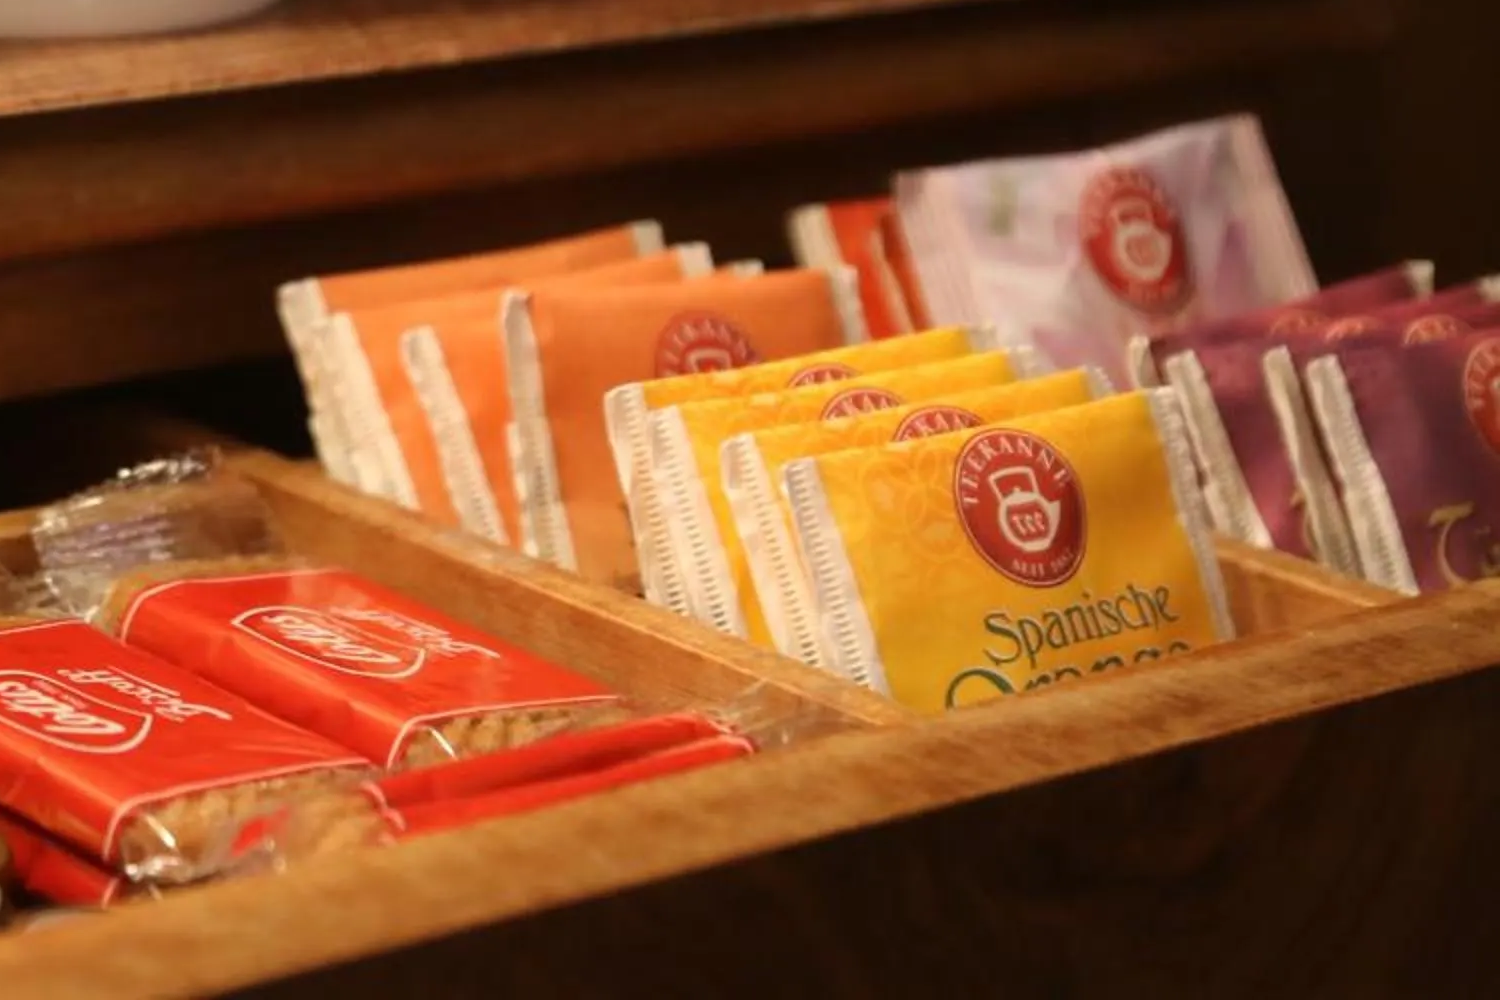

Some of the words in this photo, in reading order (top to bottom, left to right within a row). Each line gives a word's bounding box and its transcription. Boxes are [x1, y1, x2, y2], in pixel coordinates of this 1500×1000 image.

[961, 436, 1070, 505] TEEKANNE
[262, 614, 402, 664] Lotus
[983, 583, 1180, 668] Spanische
[56, 666, 233, 723] Biscoff
